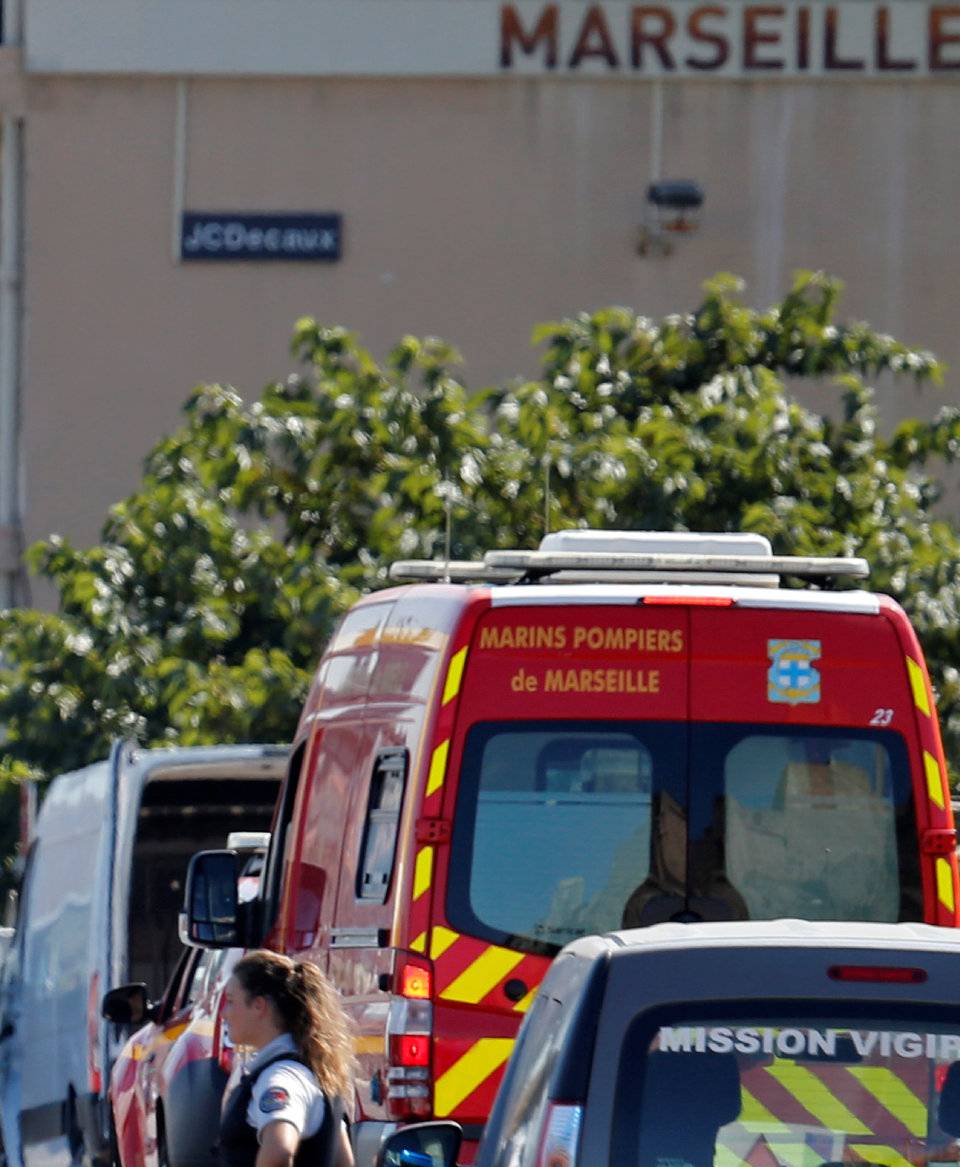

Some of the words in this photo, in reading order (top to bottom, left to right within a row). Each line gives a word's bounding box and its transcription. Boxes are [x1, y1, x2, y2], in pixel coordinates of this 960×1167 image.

[499, 4, 960, 71] MARSEILLE
[480, 626, 566, 649] MARINS
[573, 627, 683, 652] POMPIERS
[511, 668, 537, 692] de
[544, 669, 660, 693] MARSEILLE
[869, 708, 894, 727] 23
[659, 1026, 836, 1056] MISSION
